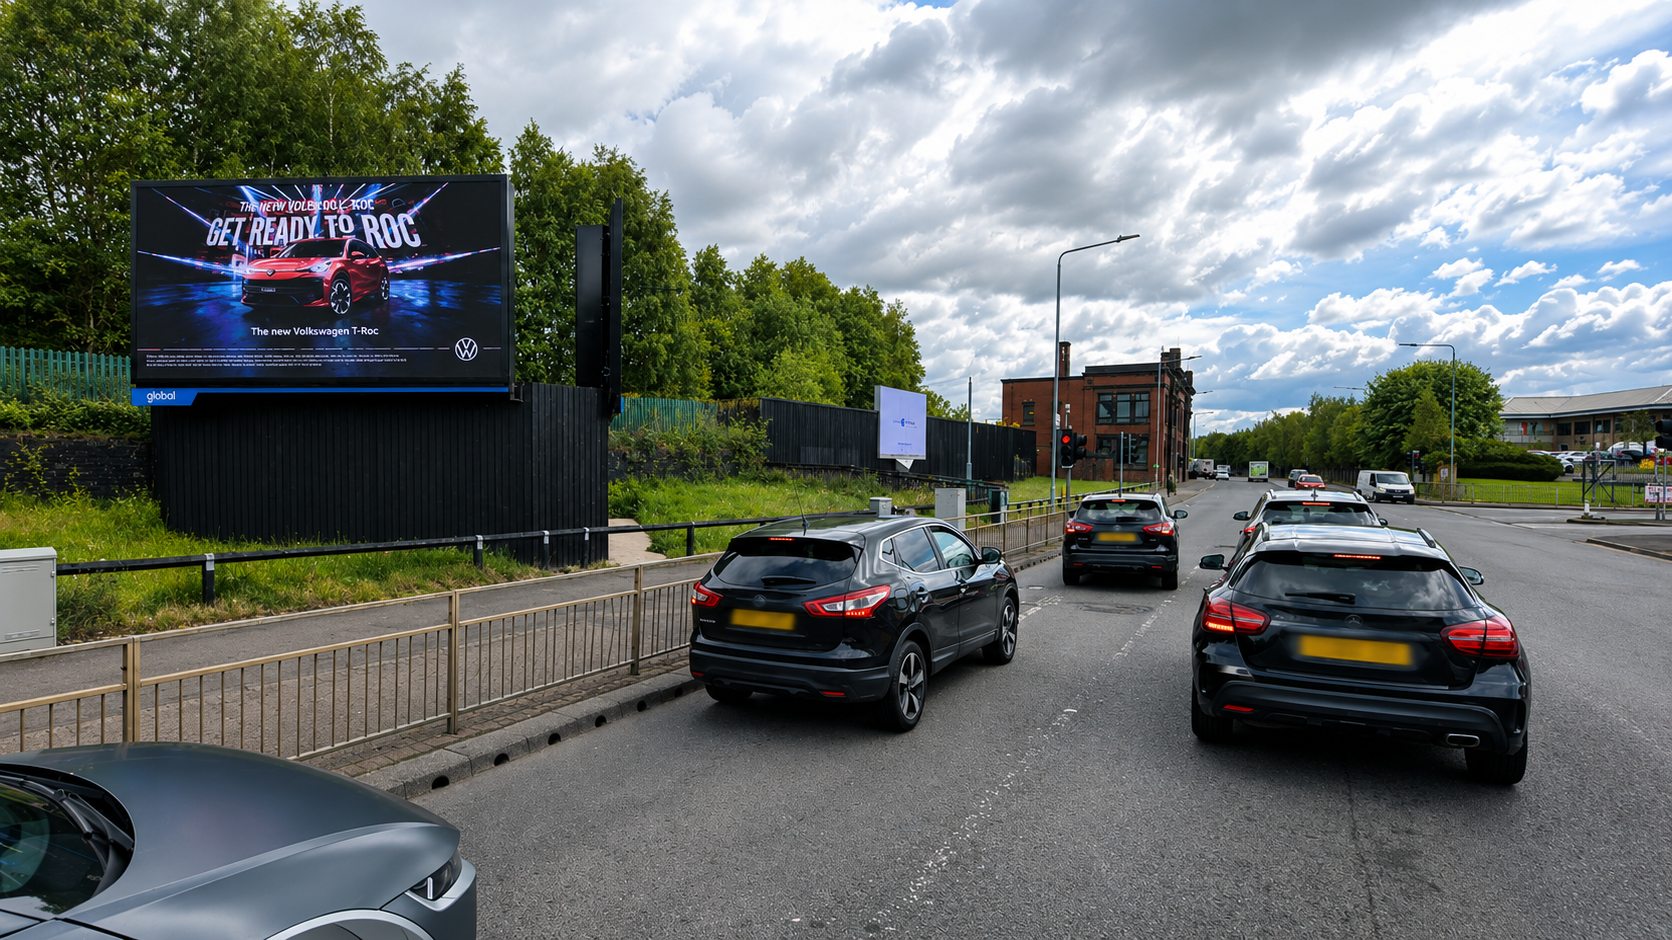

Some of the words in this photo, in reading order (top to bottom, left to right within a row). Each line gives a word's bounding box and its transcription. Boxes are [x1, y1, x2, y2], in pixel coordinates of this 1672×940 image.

[206, 216, 247, 246] GET
[248, 215, 318, 247] READY
[324, 214, 355, 239] TO
[361, 212, 422, 249] ROC
[251, 327, 269, 336] The
[271, 328, 291, 336] new
[293, 326, 350, 338] Volkswagen
[351, 326, 379, 335] T-Roc
[146, 390, 176, 404] global
